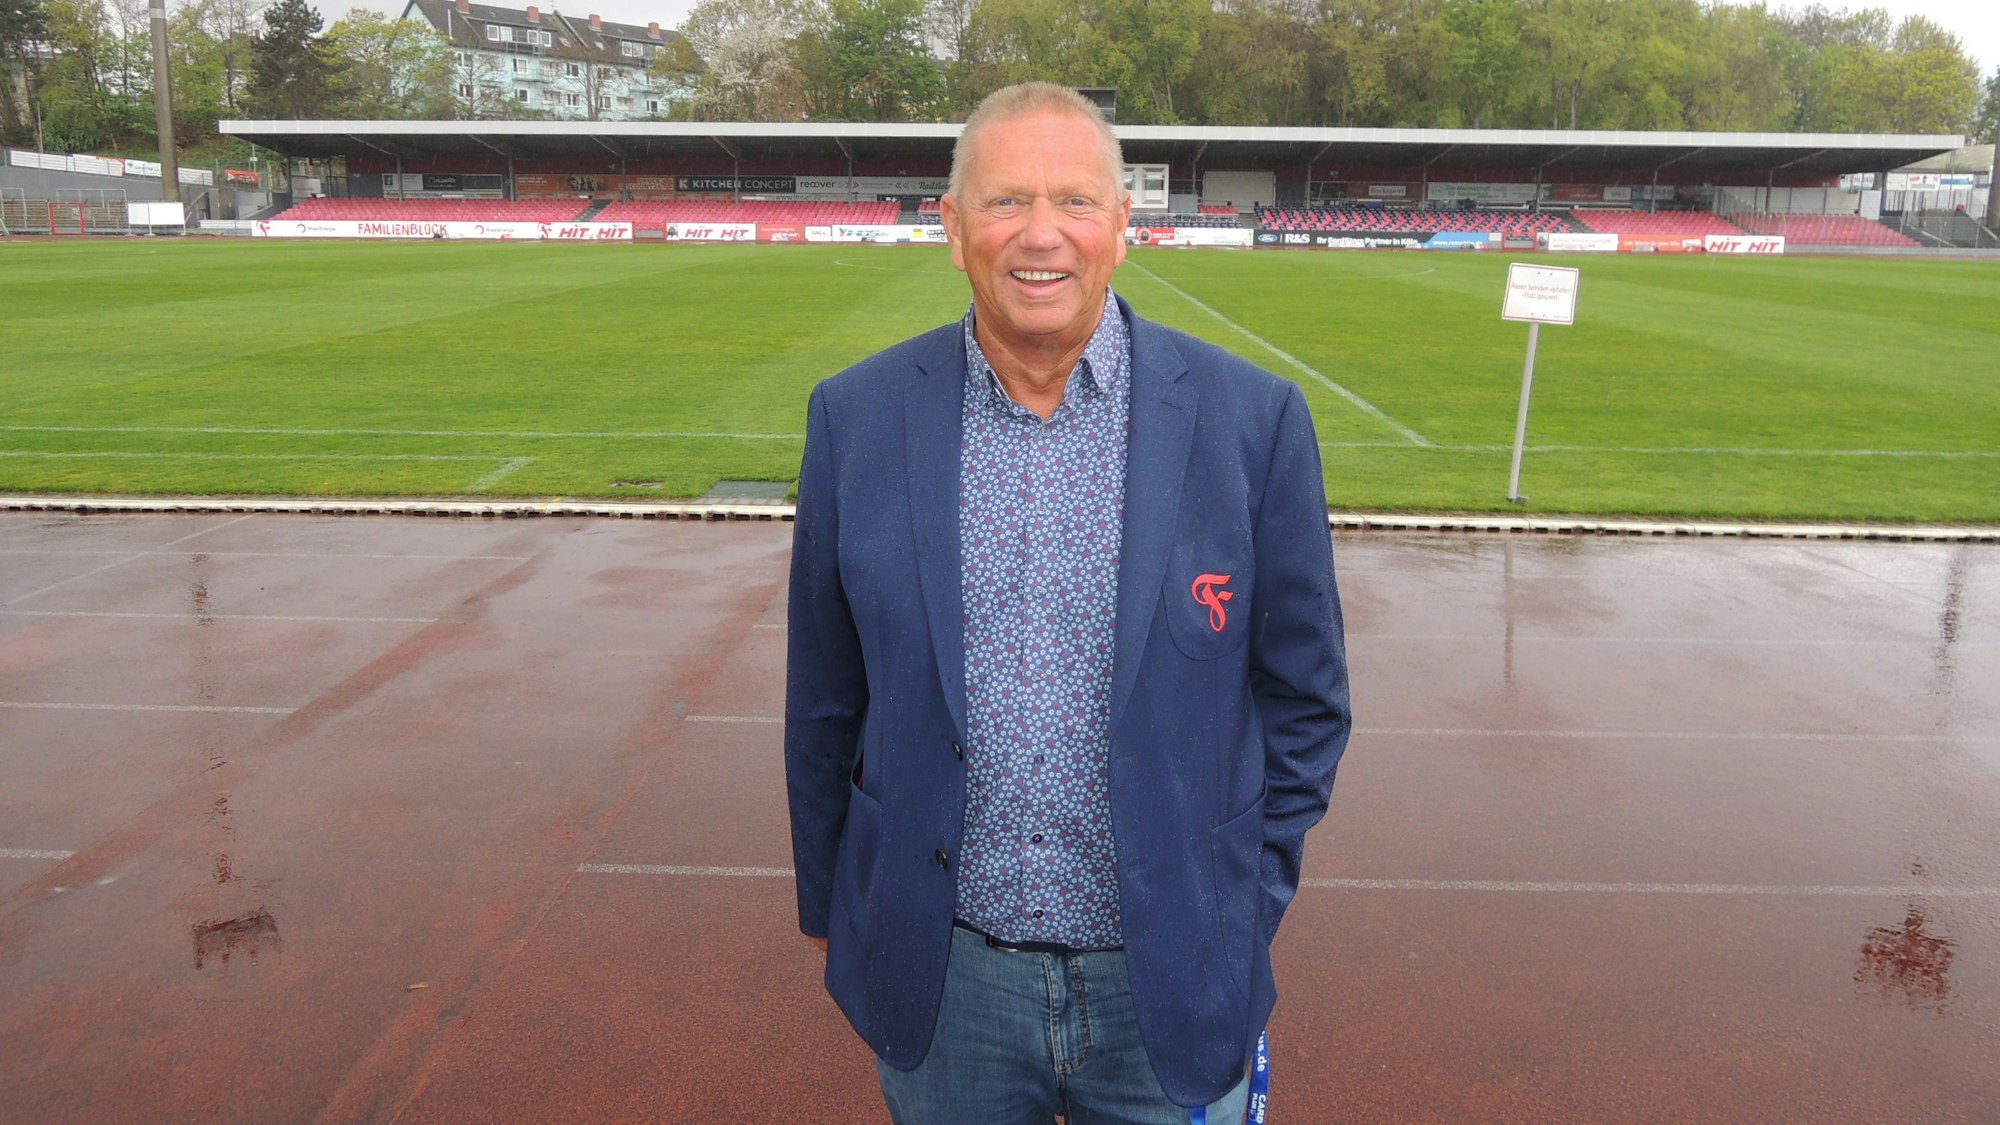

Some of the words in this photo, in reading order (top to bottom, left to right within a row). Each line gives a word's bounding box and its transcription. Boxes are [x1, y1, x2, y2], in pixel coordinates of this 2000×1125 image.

[692, 180, 741, 189] KITCHEN
[744, 180, 794, 189] CONCEPT
[358, 223, 447, 236] FAMILIENBLOCK
[559, 225, 590, 238] HIT
[597, 225, 628, 238] HIT
[685, 227, 713, 238] HIT
[720, 227, 749, 238] HIT
[1285, 233, 1310, 244] R&S
[1365, 238, 1391, 246] Partner
[1401, 238, 1418, 246] Köln
[1709, 238, 1741, 252] HIT
[1748, 238, 1780, 252] HIT
[1257, 1030, 1267, 1072] us.de
[1256, 1094, 1266, 1124] CARD
